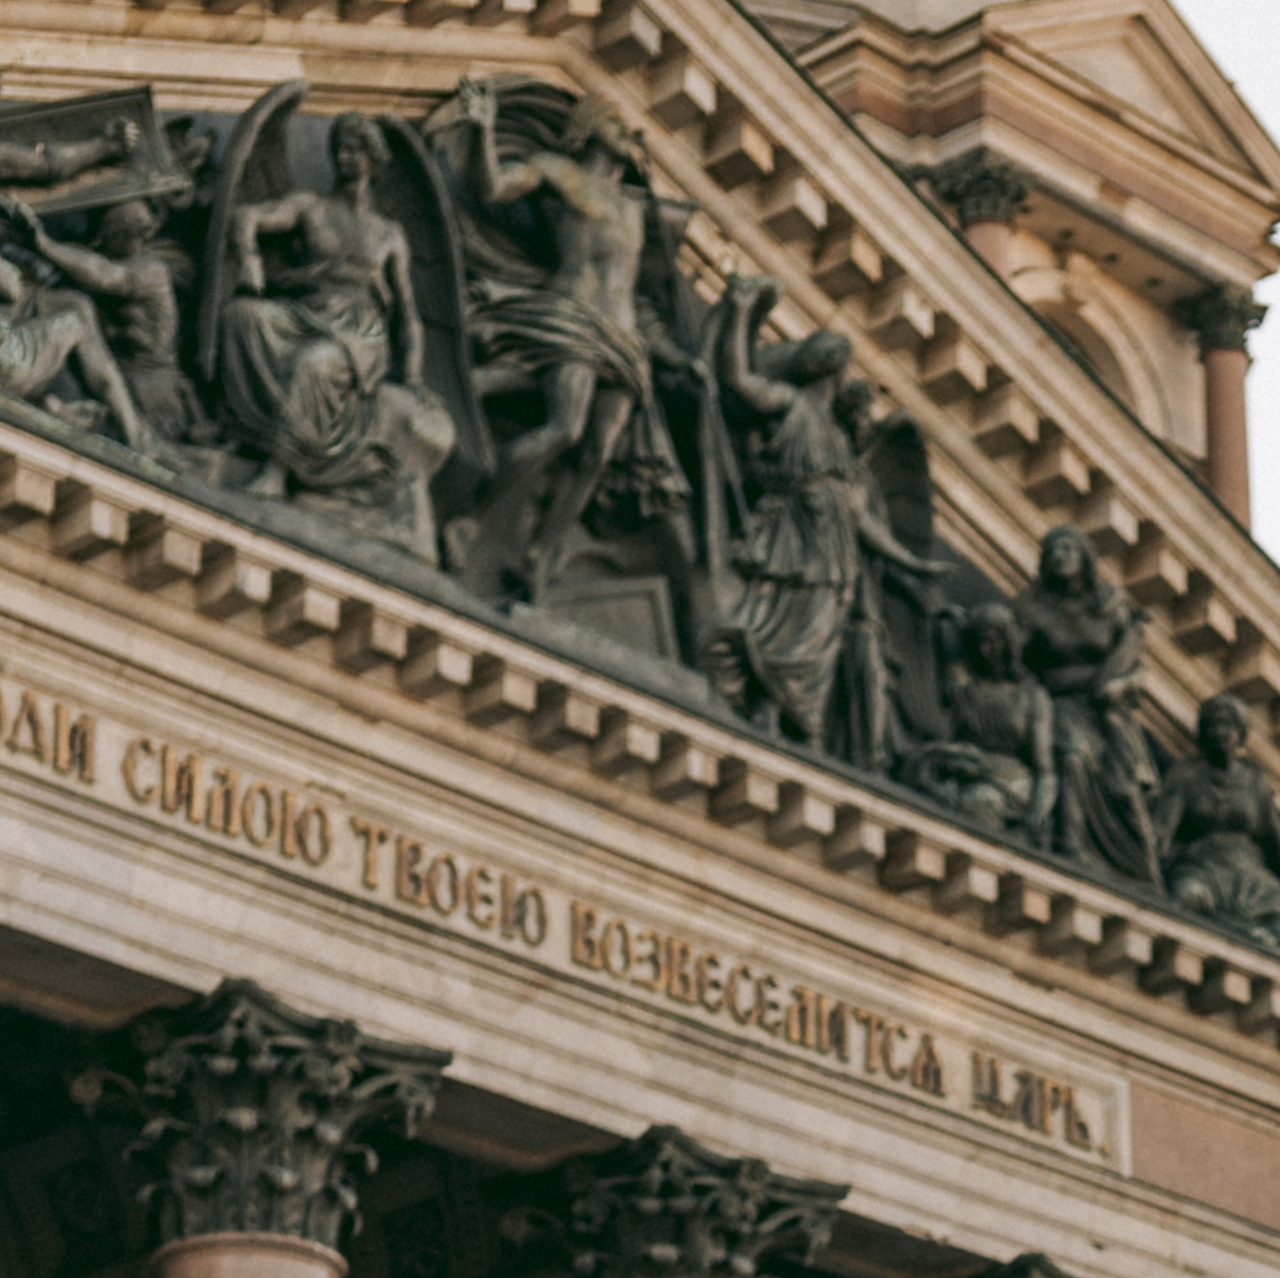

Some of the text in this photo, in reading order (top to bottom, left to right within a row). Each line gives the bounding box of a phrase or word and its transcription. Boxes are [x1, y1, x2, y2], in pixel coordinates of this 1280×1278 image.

[0, 690, 95, 784] ДИ
[121, 736, 333, 866] СИЛОЮ
[349, 817, 548, 947] ТВОЕЮ
